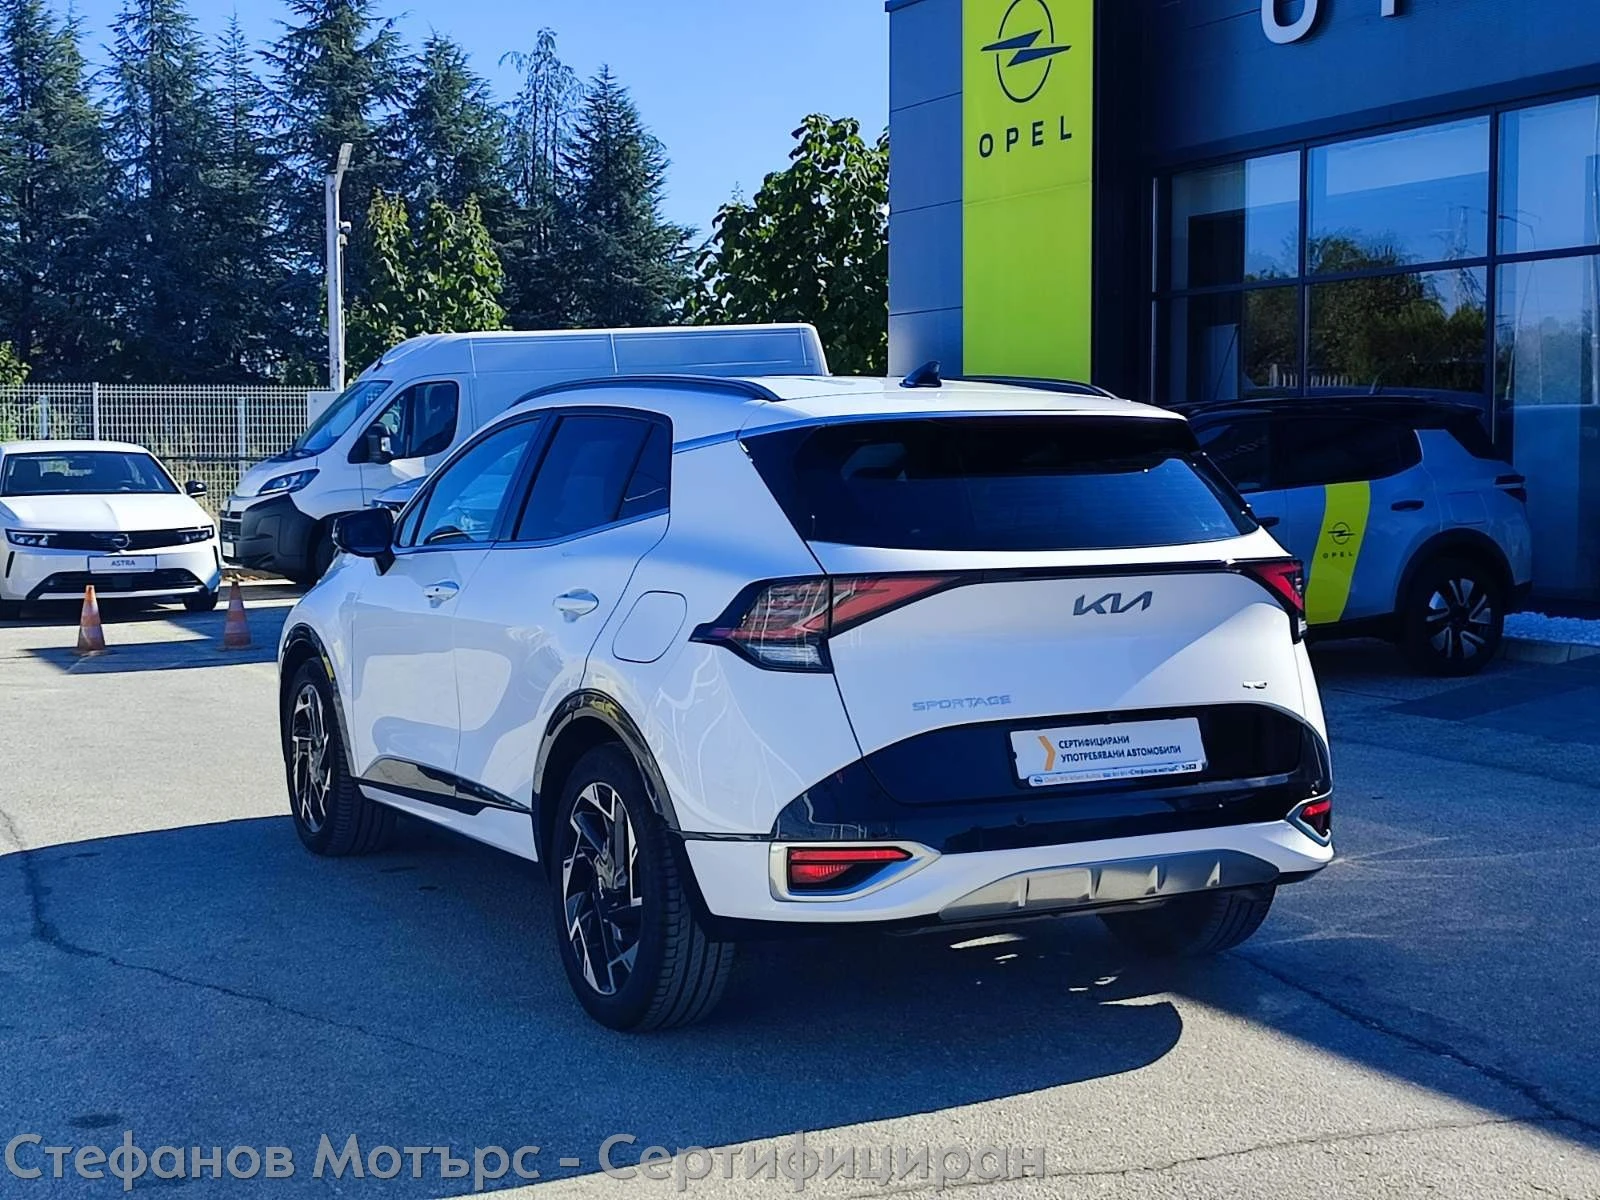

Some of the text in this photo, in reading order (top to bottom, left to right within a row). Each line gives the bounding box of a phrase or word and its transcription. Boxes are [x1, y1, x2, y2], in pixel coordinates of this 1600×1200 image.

[978, 114, 1073, 159] OPEL
[111, 559, 136, 567] ASTRA
[1322, 551, 1353, 559] OPEL
[1073, 590, 1153, 616] KIA
[912, 694, 1012, 712] SPORTAGE
[1058, 735, 1130, 749] СЕРТИФИЦИРАНИ
[1060, 745, 1182, 763] УПОТРЕБЯВАНИ АВТОМОБИЛИ
